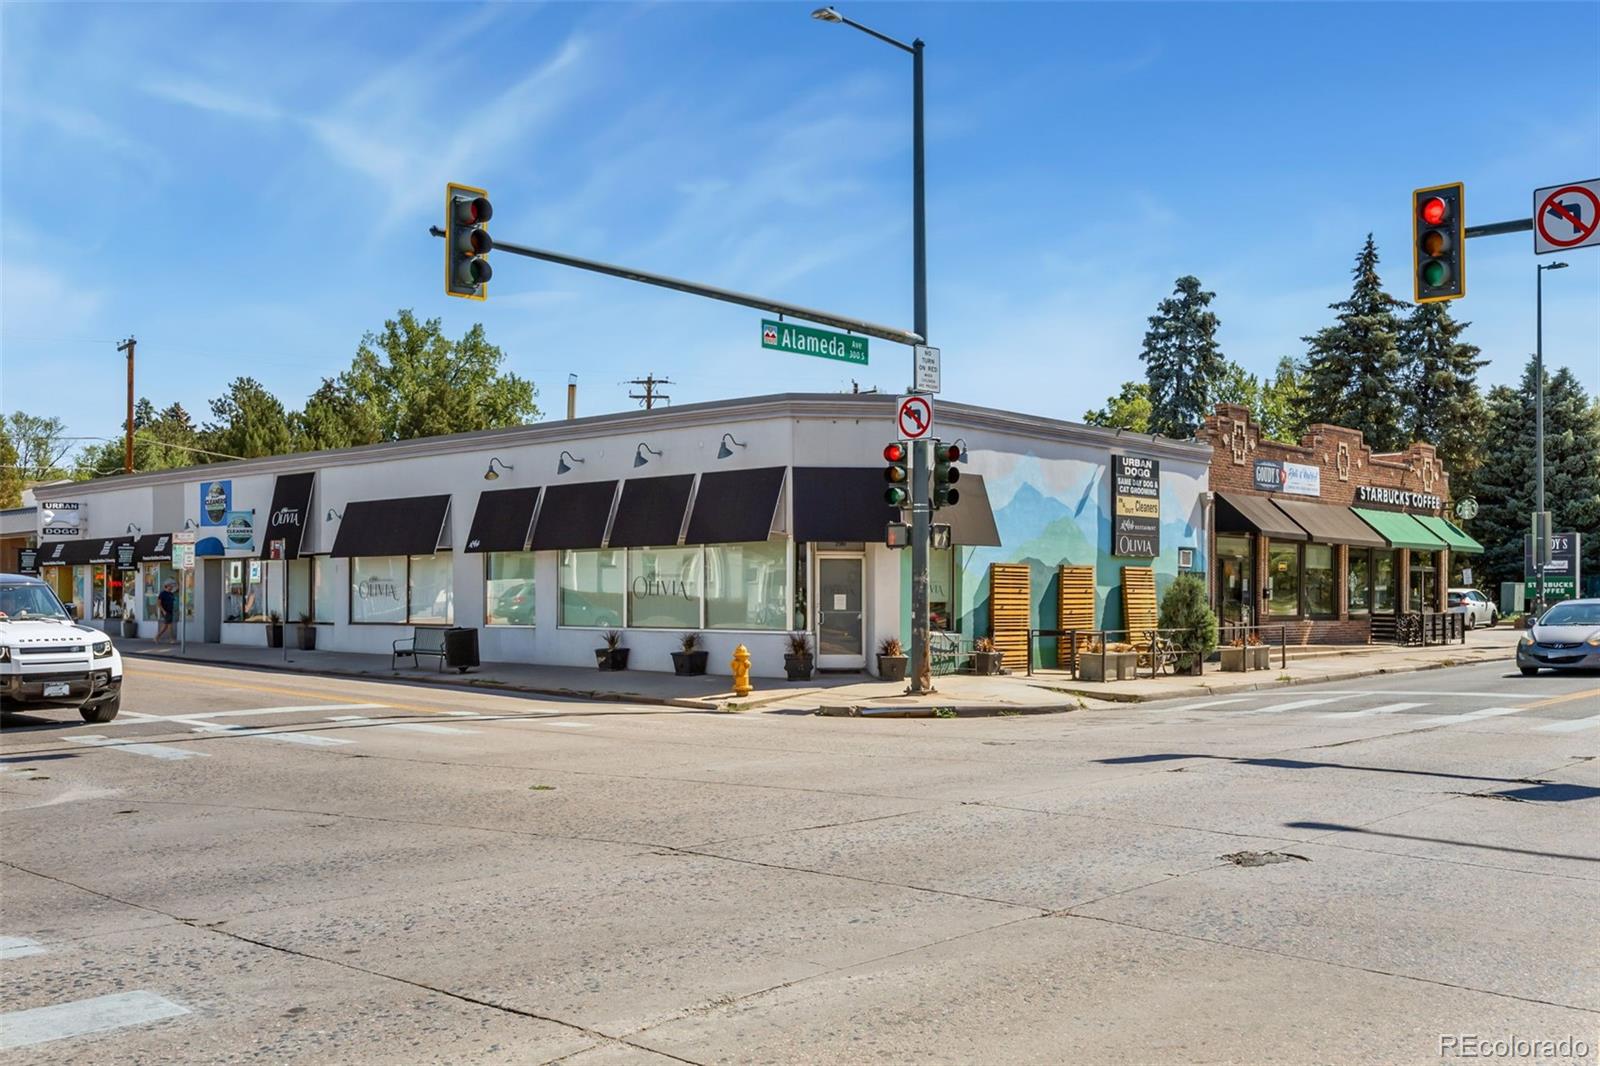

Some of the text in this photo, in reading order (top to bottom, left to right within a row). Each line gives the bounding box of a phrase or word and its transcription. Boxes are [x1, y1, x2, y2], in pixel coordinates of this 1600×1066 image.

[781, 328, 845, 357] Alameda
[851, 340, 863, 350] Ave
[849, 350, 860, 360] 300
[922, 357, 935, 365] TURN
[1122, 457, 1152, 469] URBAN
[1124, 466, 1151, 478] DOGG
[1117, 477, 1131, 486] SAME
[1132, 479, 1142, 487] DAY
[1142, 480, 1154, 488] DOG
[1119, 485, 1157, 496] CAT GROOMING
[1360, 486, 1440, 509] STARBUCKS COFFEE
[1135, 499, 1158, 514] Cleaners
